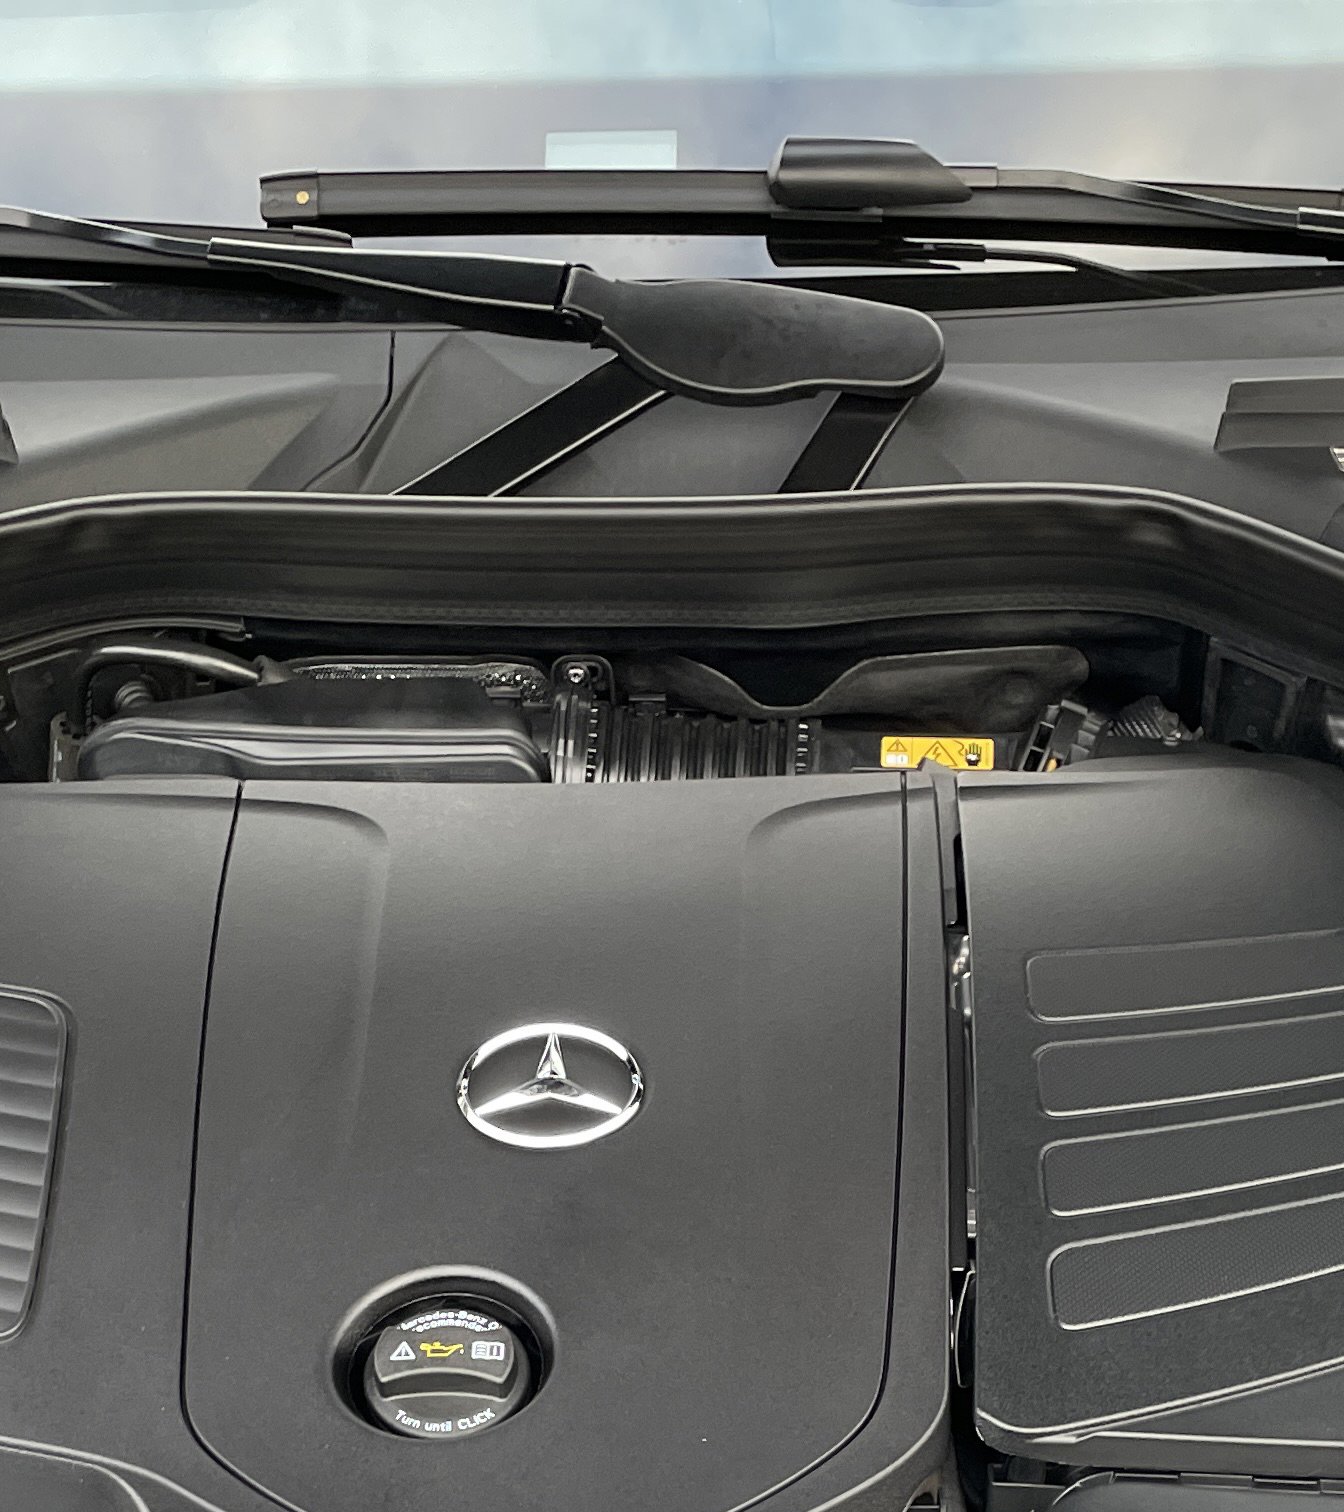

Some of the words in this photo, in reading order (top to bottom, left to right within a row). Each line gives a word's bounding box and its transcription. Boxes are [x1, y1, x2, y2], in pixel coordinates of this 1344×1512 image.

[395, 1409, 421, 1429] Turn
[424, 1420, 453, 1432] until
[457, 1407, 496, 1430] CLICK
